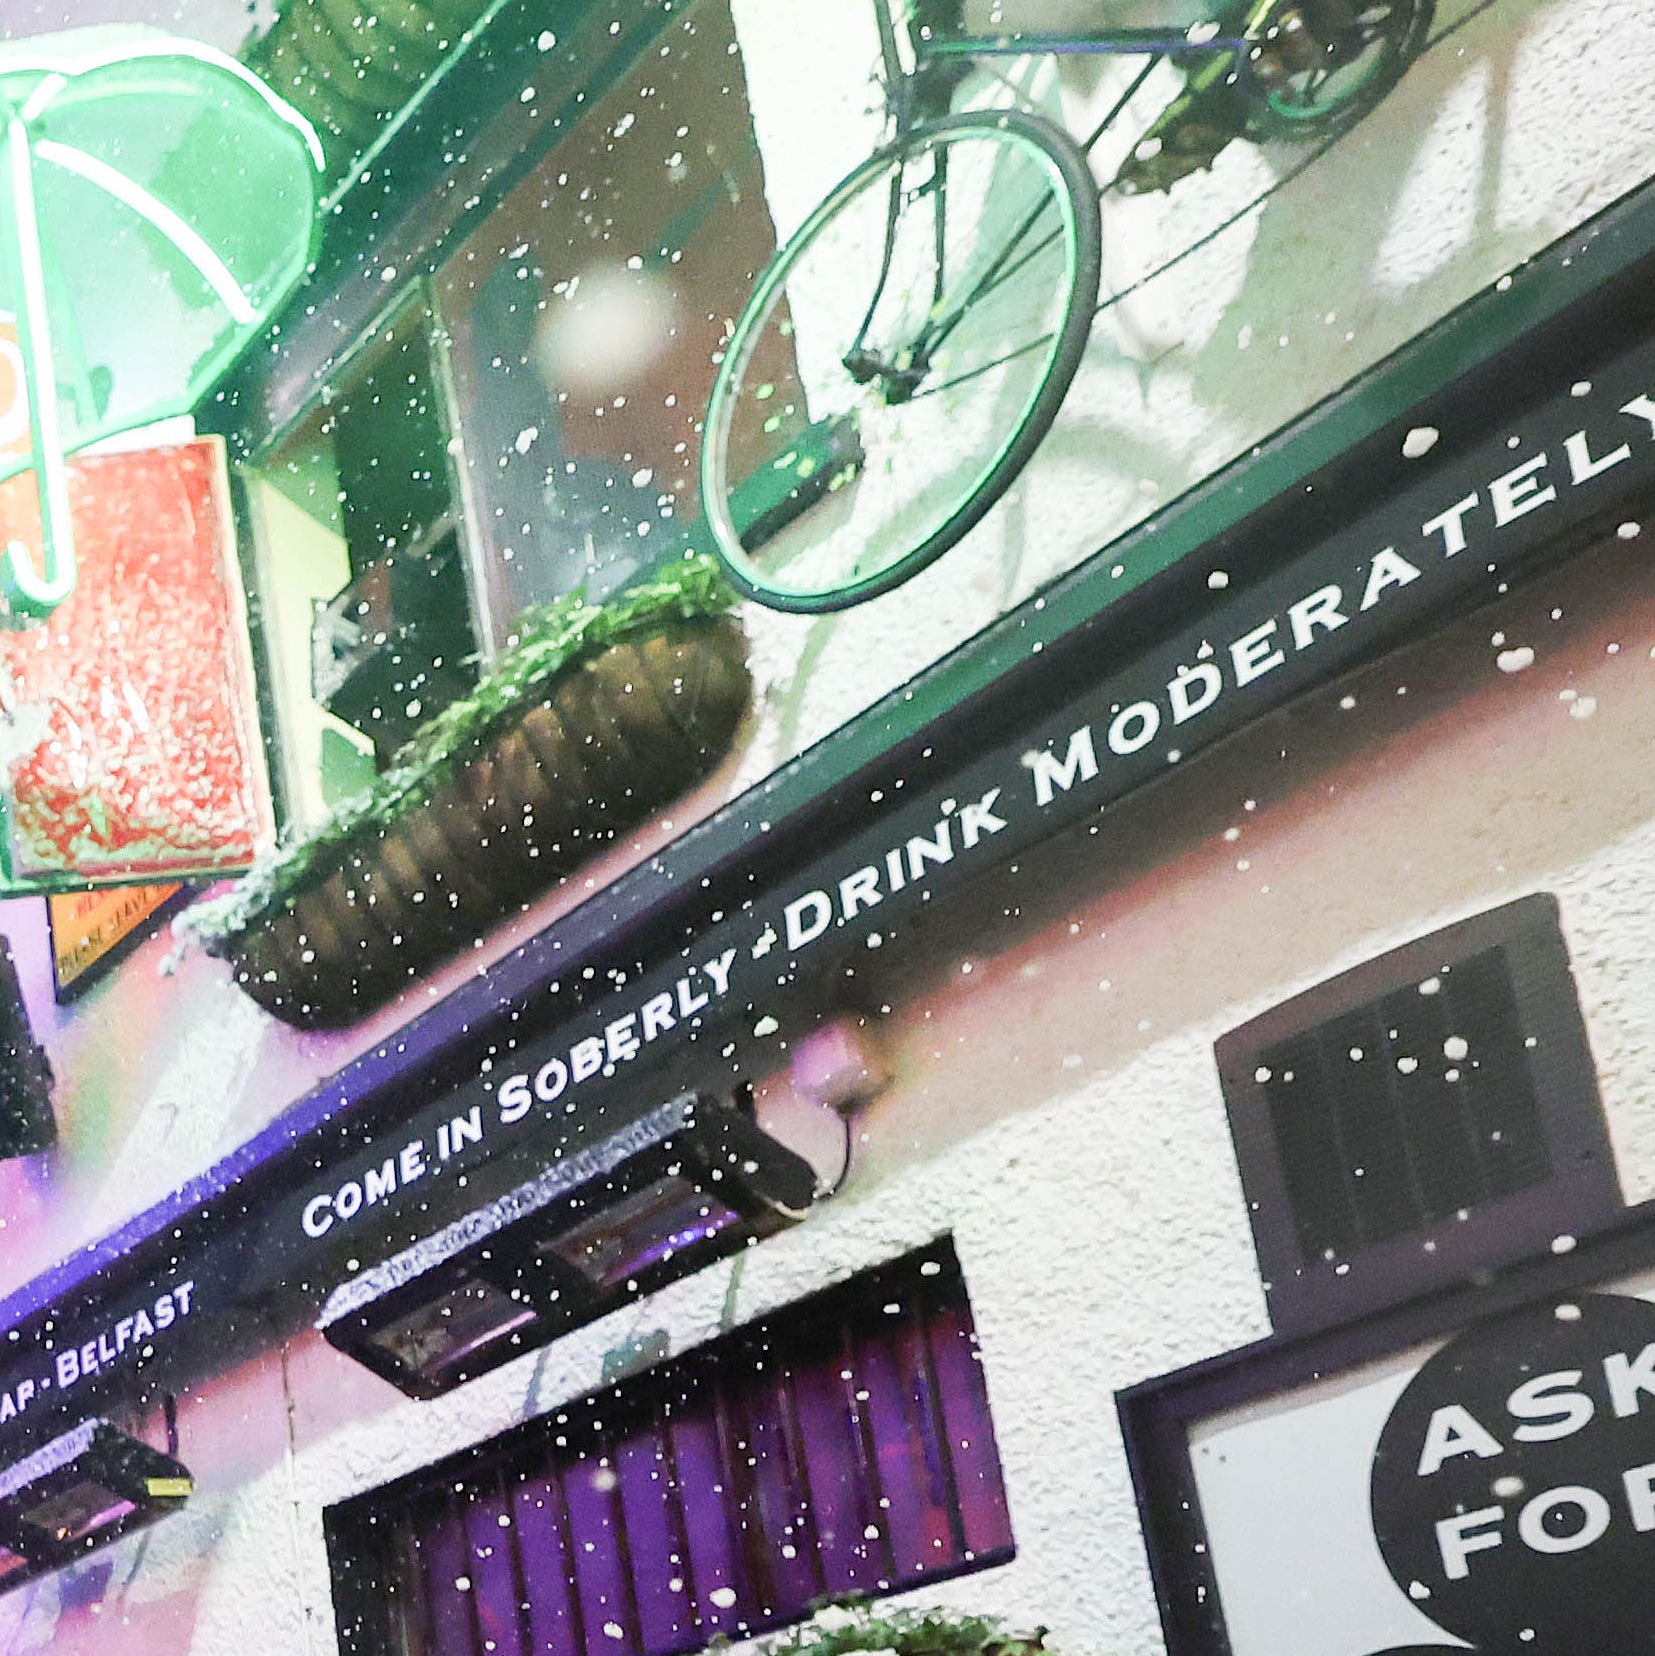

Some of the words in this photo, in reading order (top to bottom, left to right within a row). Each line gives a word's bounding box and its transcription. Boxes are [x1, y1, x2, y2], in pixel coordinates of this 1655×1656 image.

[302, 1140, 427, 1238] COME
[437, 1106, 485, 1160] IN
[497, 948, 738, 1124] SOBERLY
[784, 788, 1008, 951] DRINK
[55, 1280, 194, 1389] BELFAST
[1416, 1341, 1655, 1476] ASK
